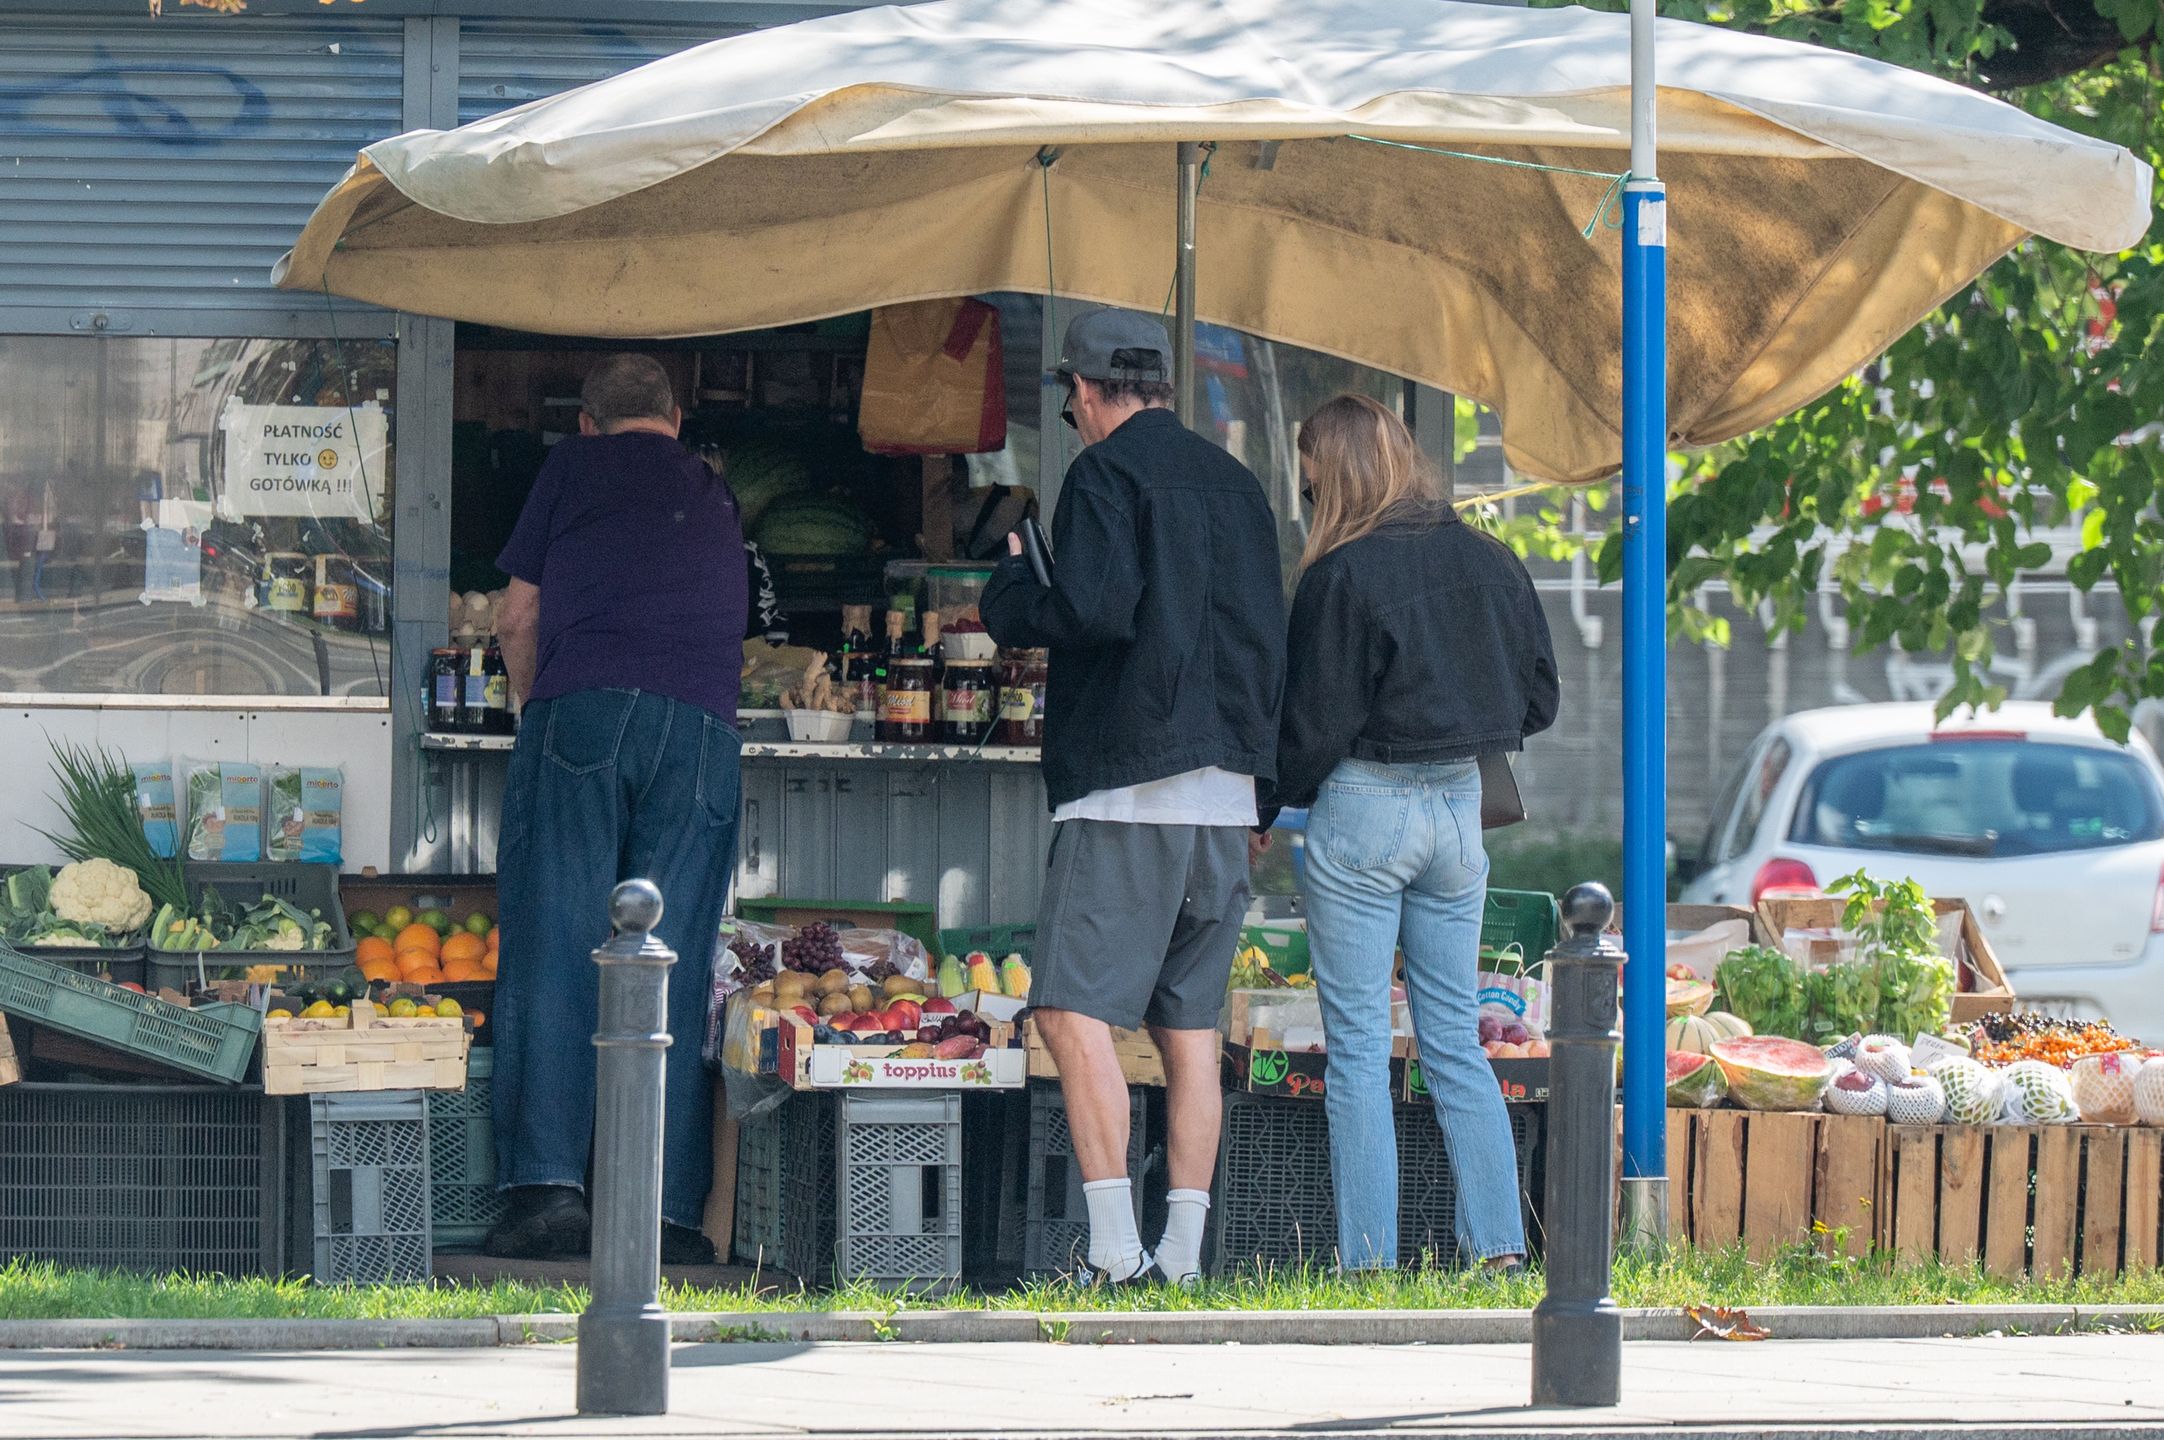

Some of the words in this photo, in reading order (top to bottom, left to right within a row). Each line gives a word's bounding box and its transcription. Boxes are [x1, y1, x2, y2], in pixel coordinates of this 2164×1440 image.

[263, 422, 343, 439] PŁATNOŚĆ
[264, 452, 311, 466] TYLKO
[250, 475, 332, 495] GOTÓWKĄ
[1477, 991, 1500, 1002] Cotton
[1501, 991, 1522, 1011] Candy
[883, 1062, 956, 1081] toppins
